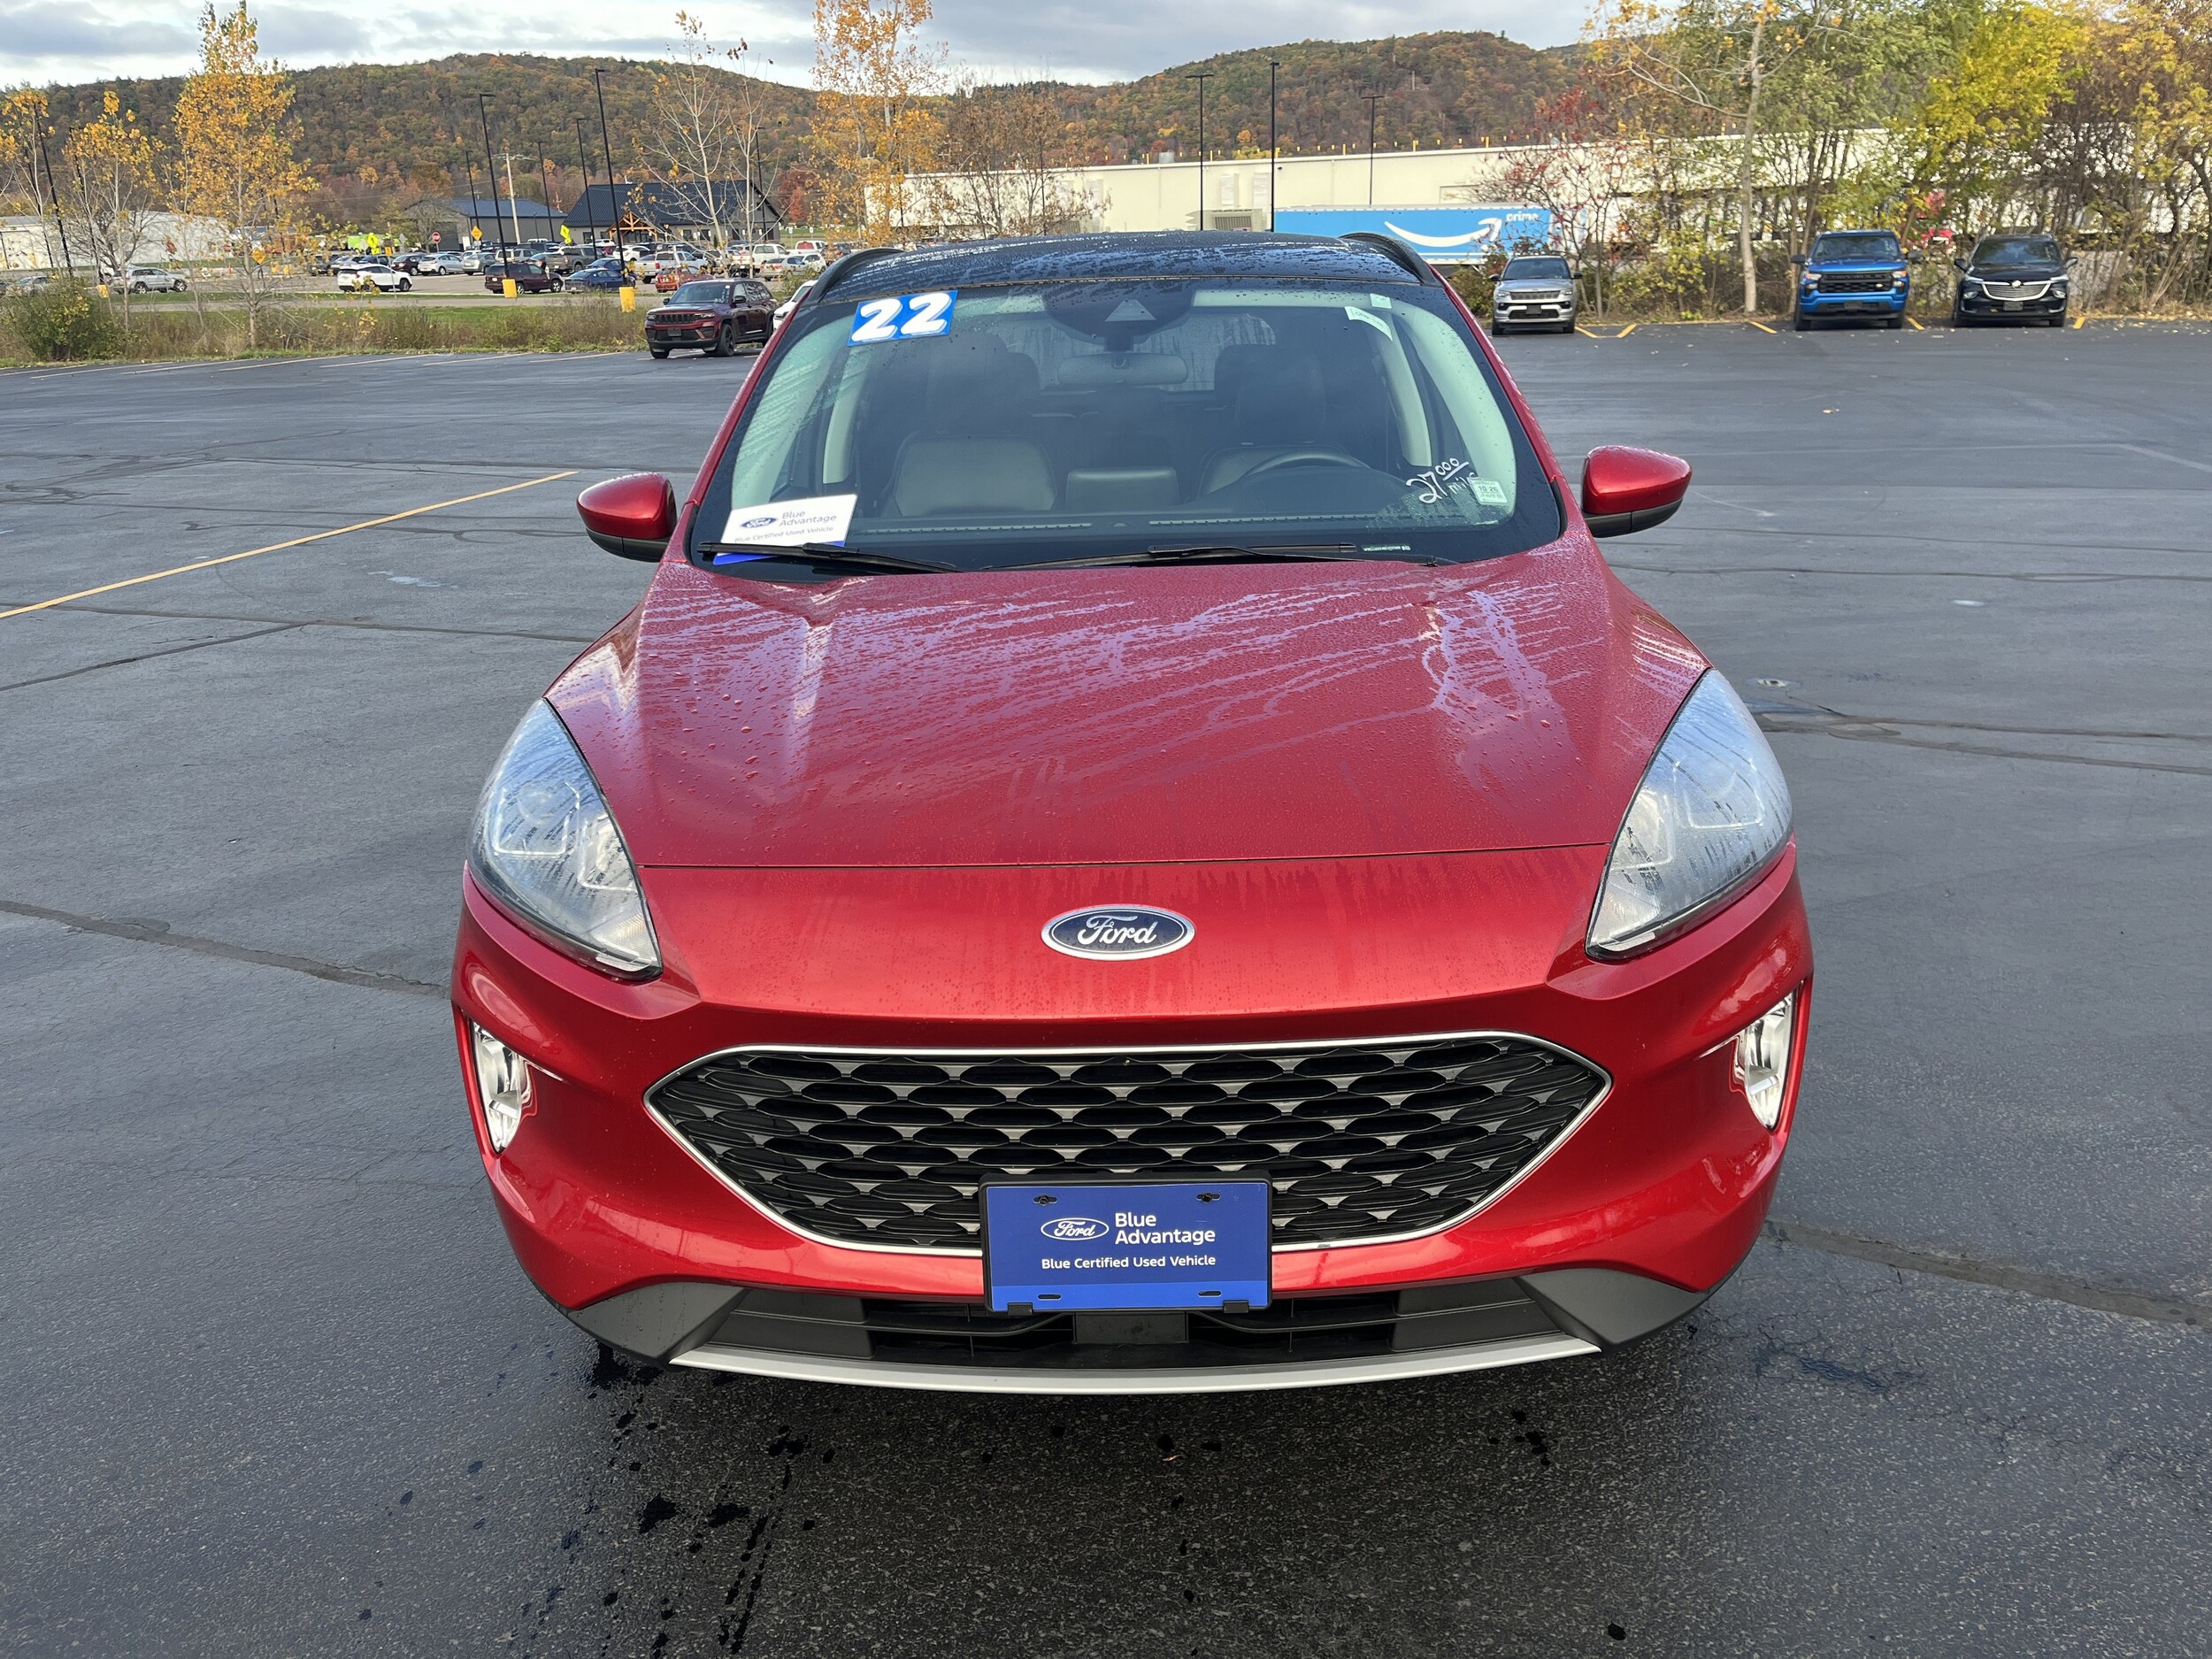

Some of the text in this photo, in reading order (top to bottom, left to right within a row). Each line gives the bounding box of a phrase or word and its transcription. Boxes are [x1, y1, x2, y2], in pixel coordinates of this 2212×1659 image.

[1506, 211, 1539, 222] prime
[851, 293, 952, 342] 22
[779, 515, 837, 527] Advantage
[782, 511, 806, 519] Blue
[752, 531, 784, 541] Certified
[1077, 915, 1158, 945] Ford
[1053, 1212, 1156, 1238] Ford Blue
[1114, 1227, 1217, 1246] Advantage
[1041, 1255, 1217, 1270] Blue Certified Used Vehicle
